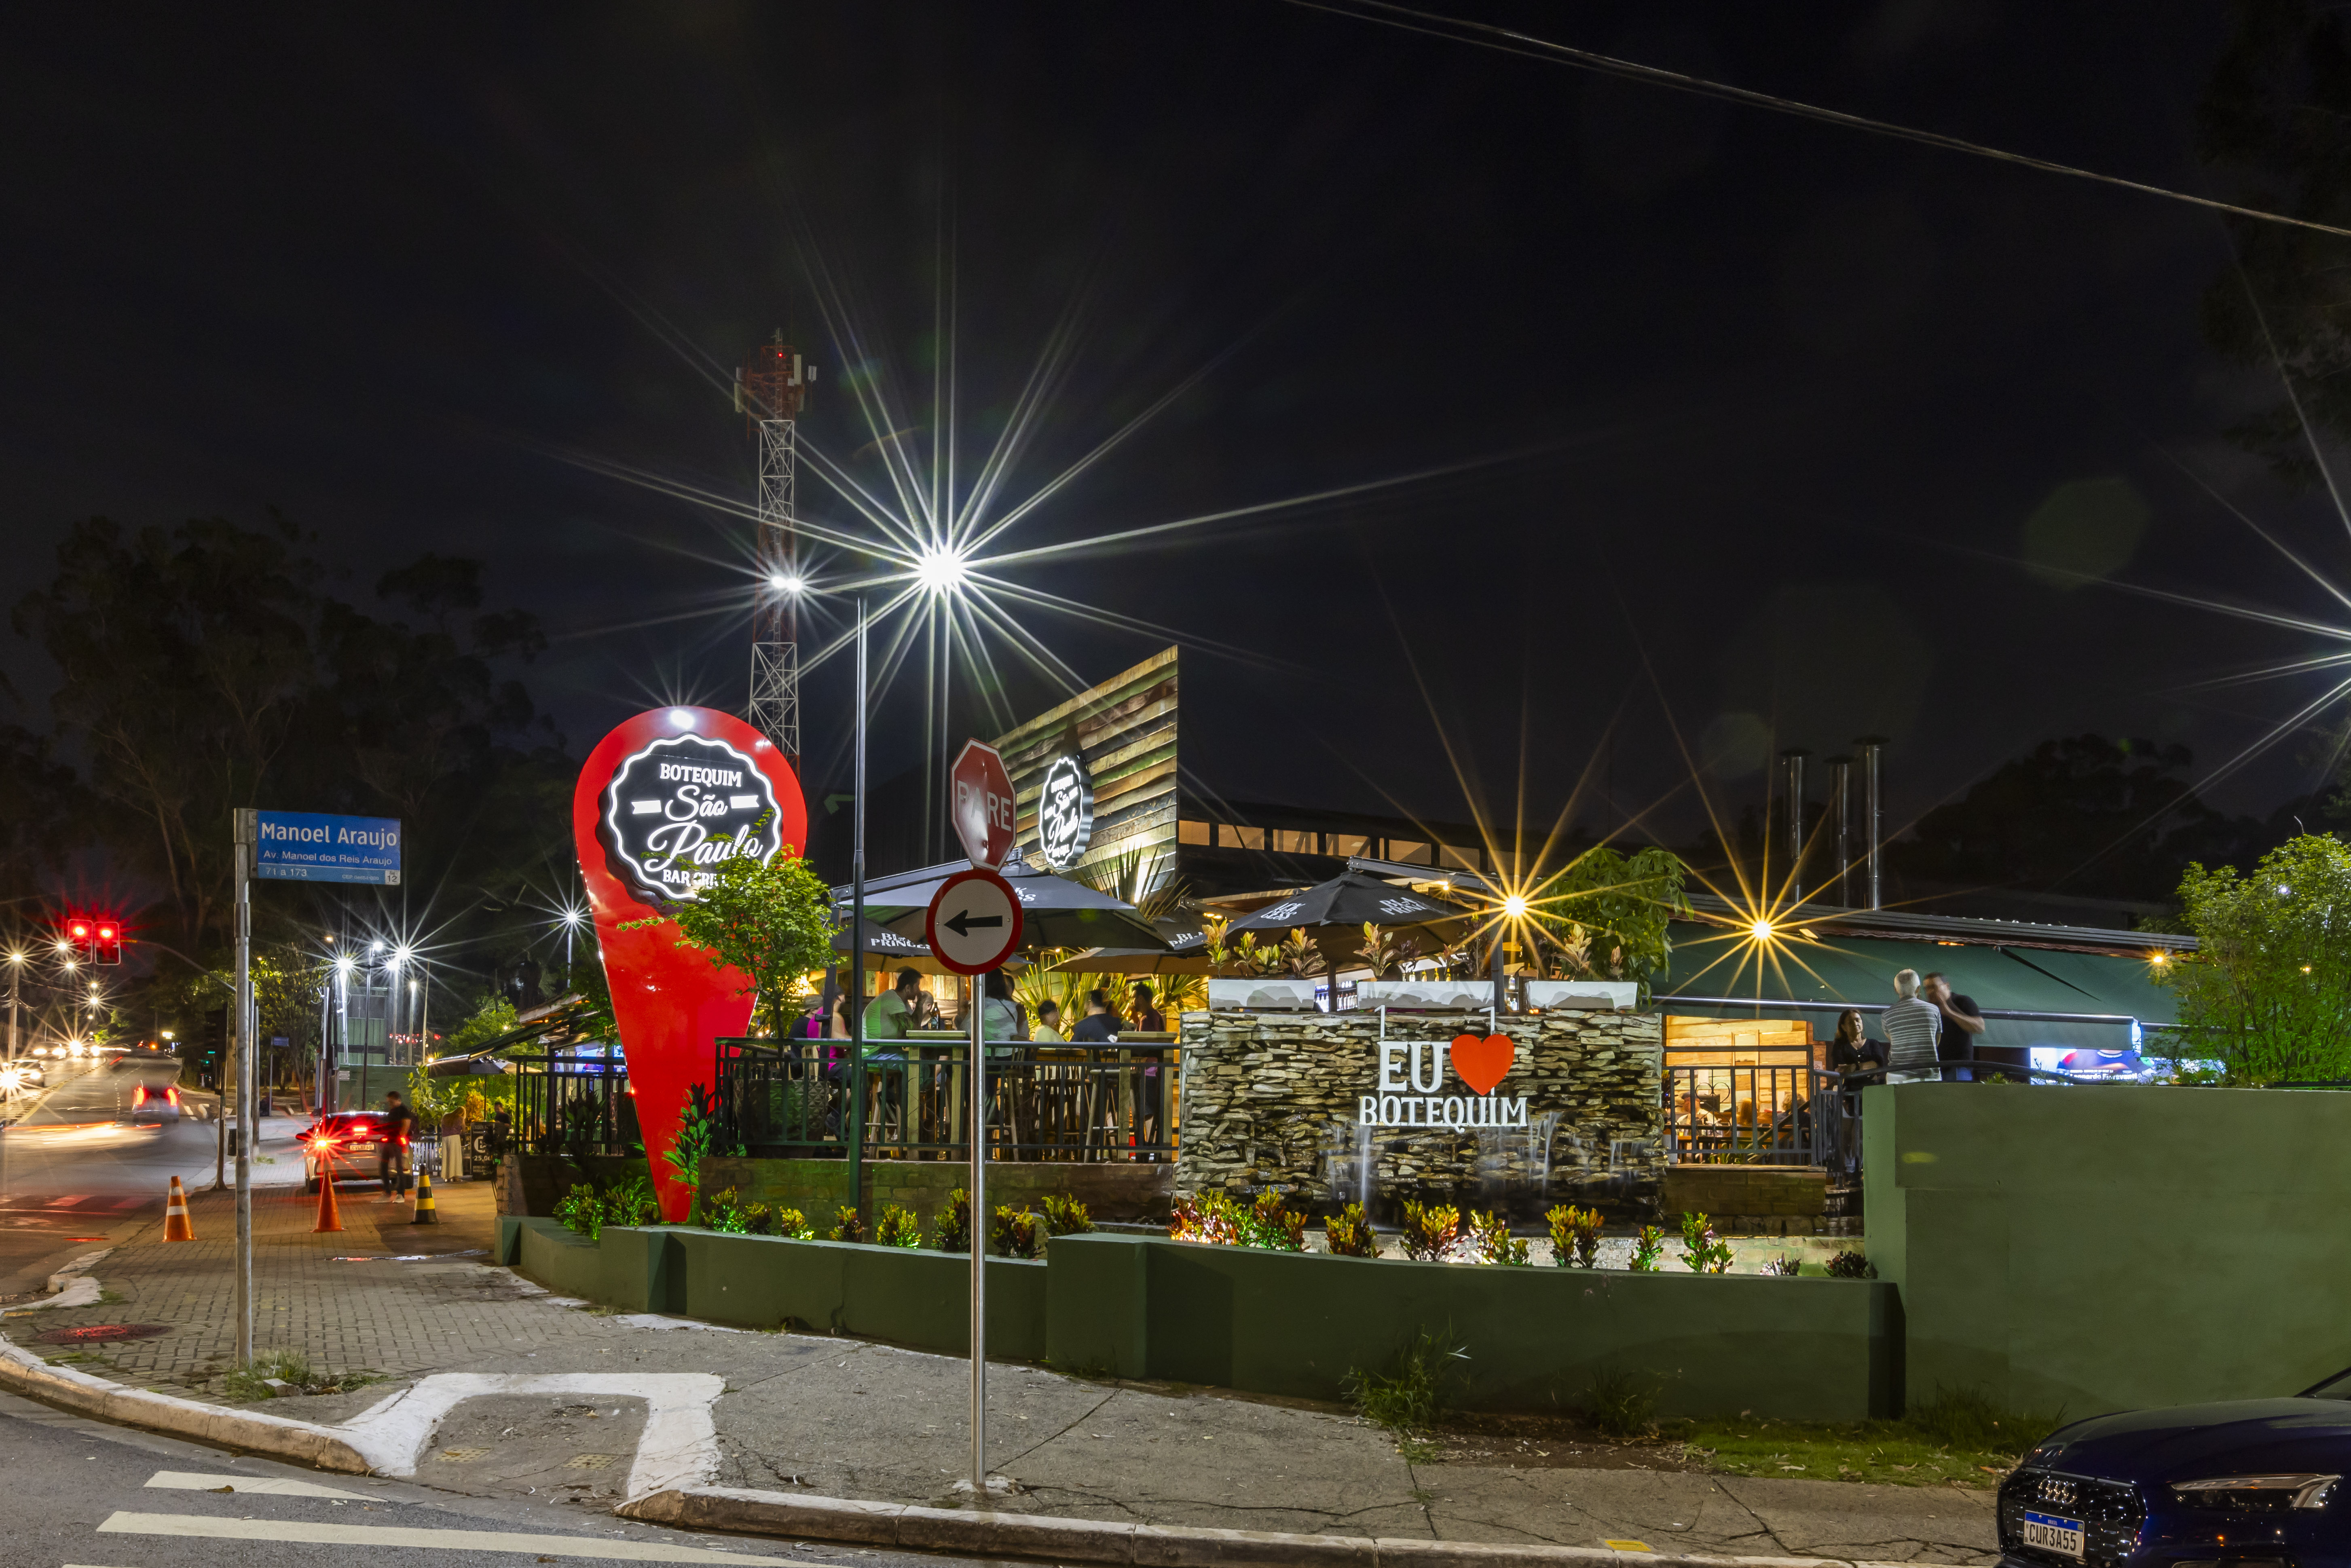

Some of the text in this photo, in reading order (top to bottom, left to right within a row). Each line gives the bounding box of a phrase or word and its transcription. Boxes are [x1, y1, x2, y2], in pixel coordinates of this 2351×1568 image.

[660, 763, 742, 788] BOTEQUIM
[665, 785, 728, 822] São
[957, 780, 1011, 832] PARE
[262, 822, 397, 850] Manoel Araujo
[644, 820, 763, 872] Paulo
[264, 850, 392, 866] Av. Manoel dos Reis Araujo
[266, 867, 276, 876] 71
[291, 868, 307, 877] 173
[662, 869, 691, 887] BAR
[1376, 1041, 1451, 1093] EU
[1359, 1095, 1528, 1133] BOTEQUIM
[2029, 1524, 2077, 1551] CUR3A55
